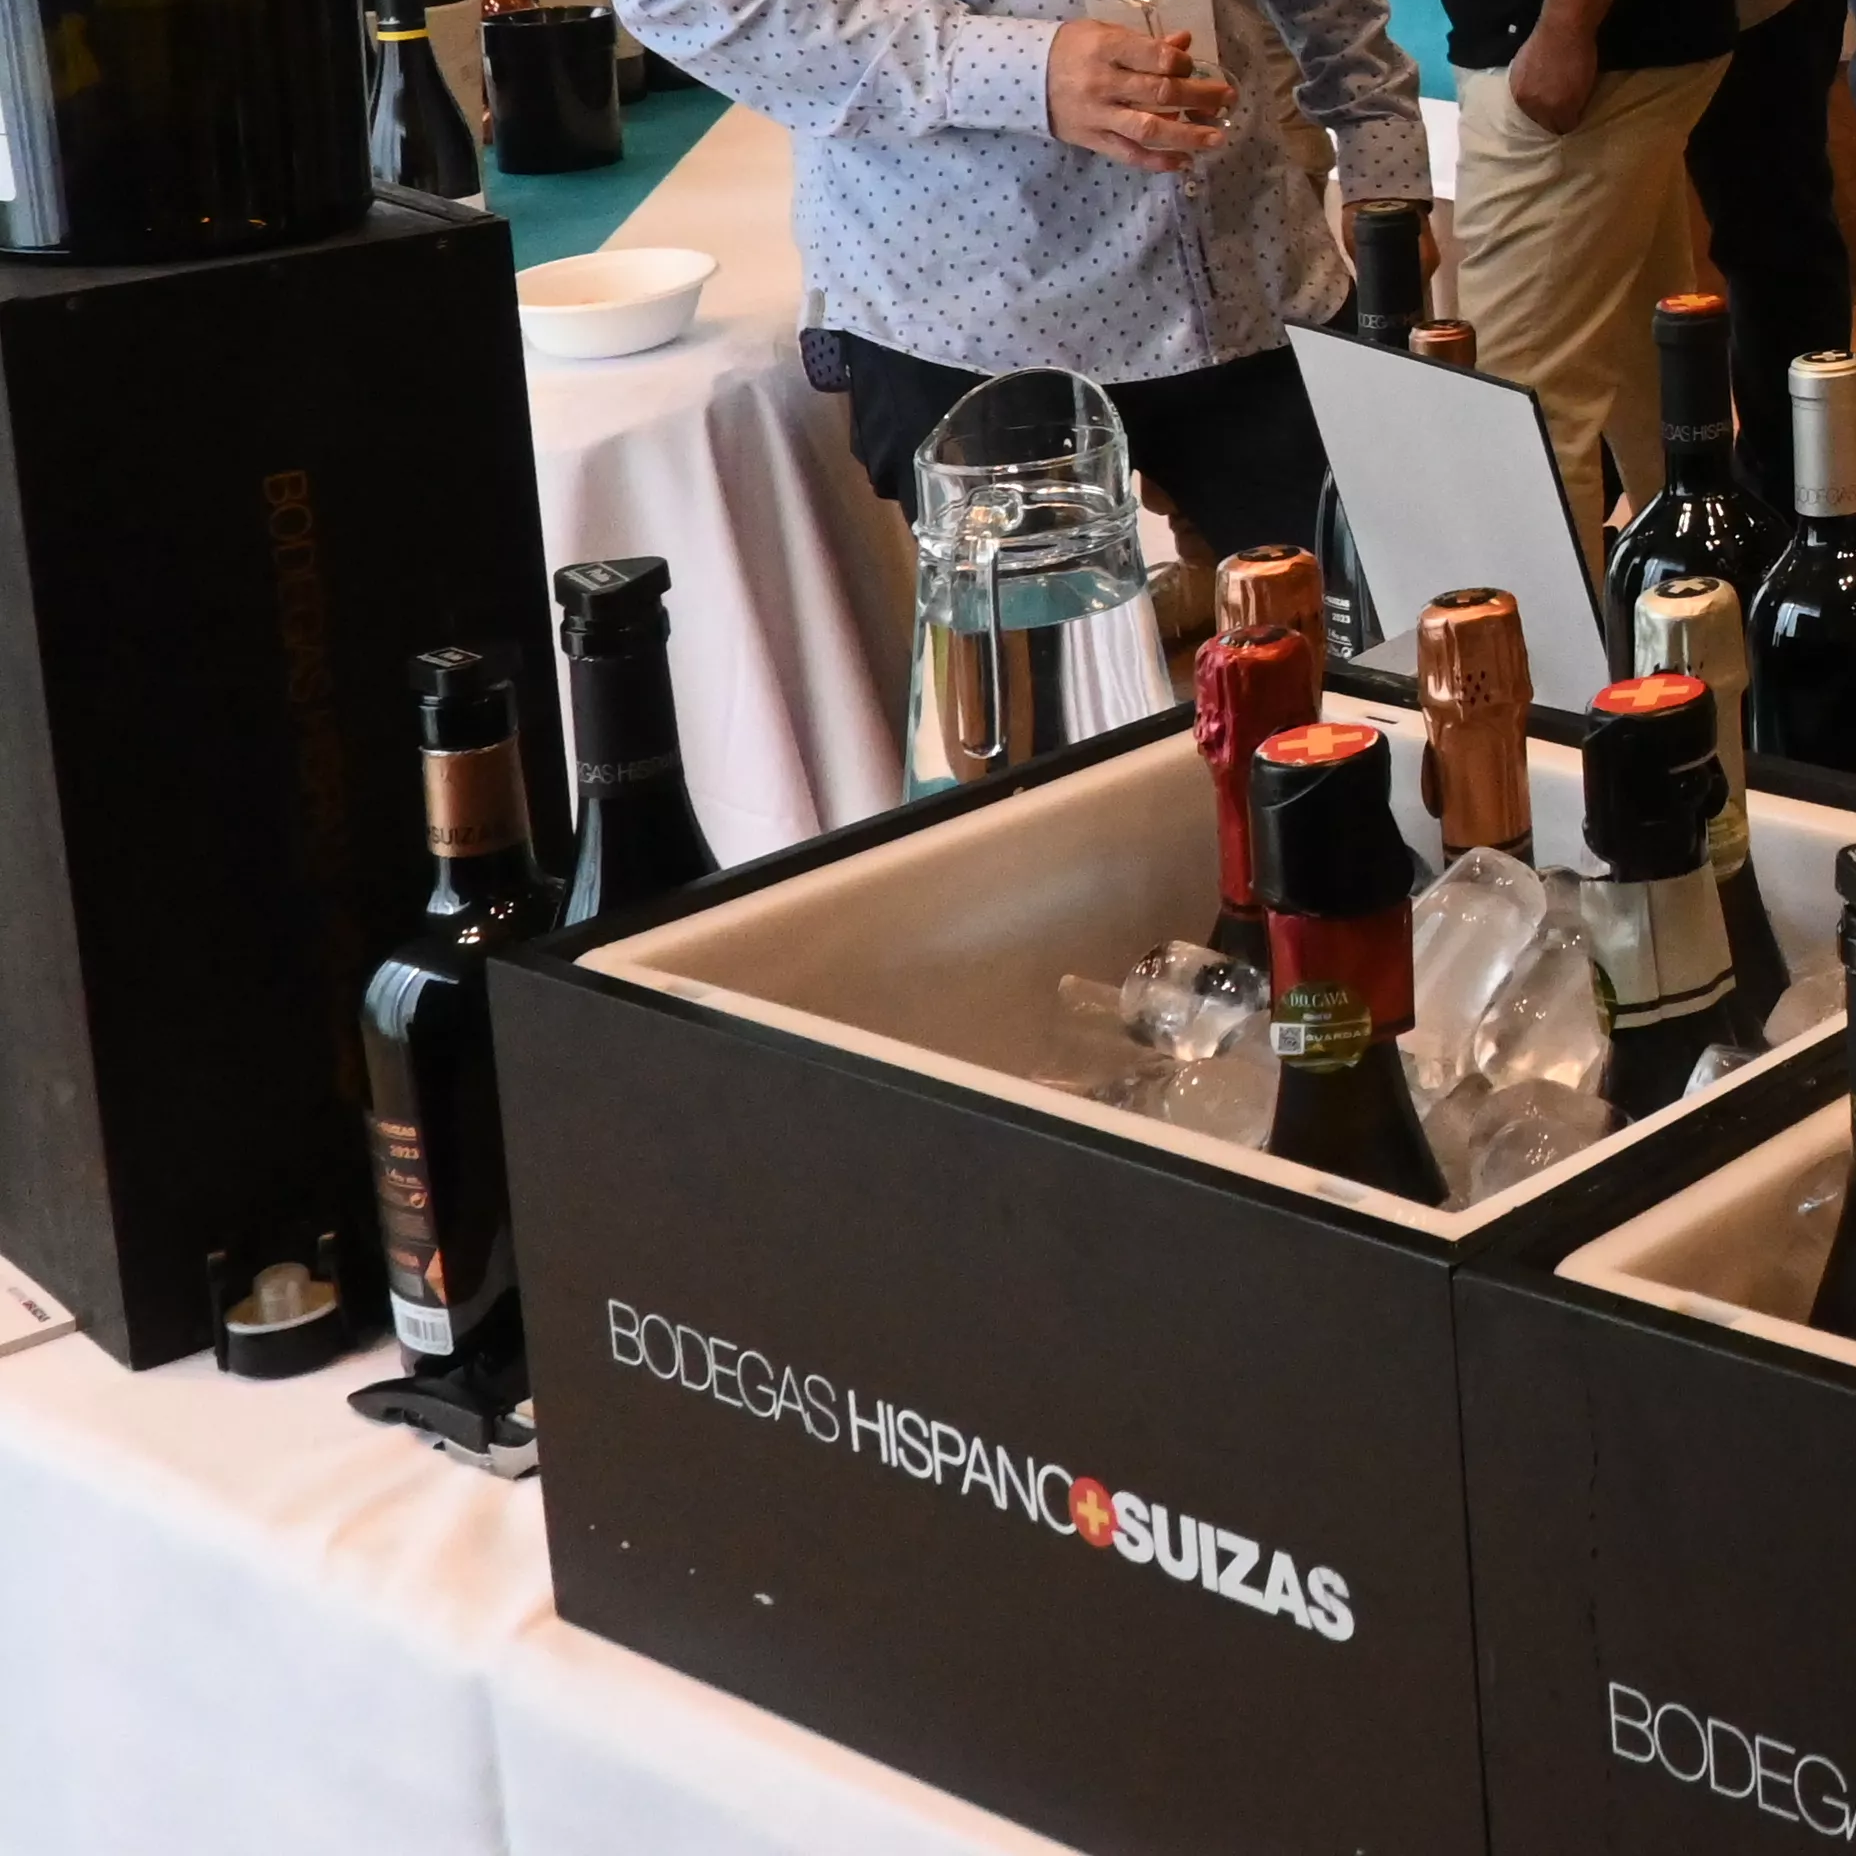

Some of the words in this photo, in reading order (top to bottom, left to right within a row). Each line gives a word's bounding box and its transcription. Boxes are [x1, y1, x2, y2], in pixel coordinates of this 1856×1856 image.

[1311, 990, 1349, 1008] CAVA
[607, 1298, 841, 1444] BODEGAS
[847, 1390, 1080, 1537] HISPANO
[1111, 1490, 1355, 1642] SUIZAS
